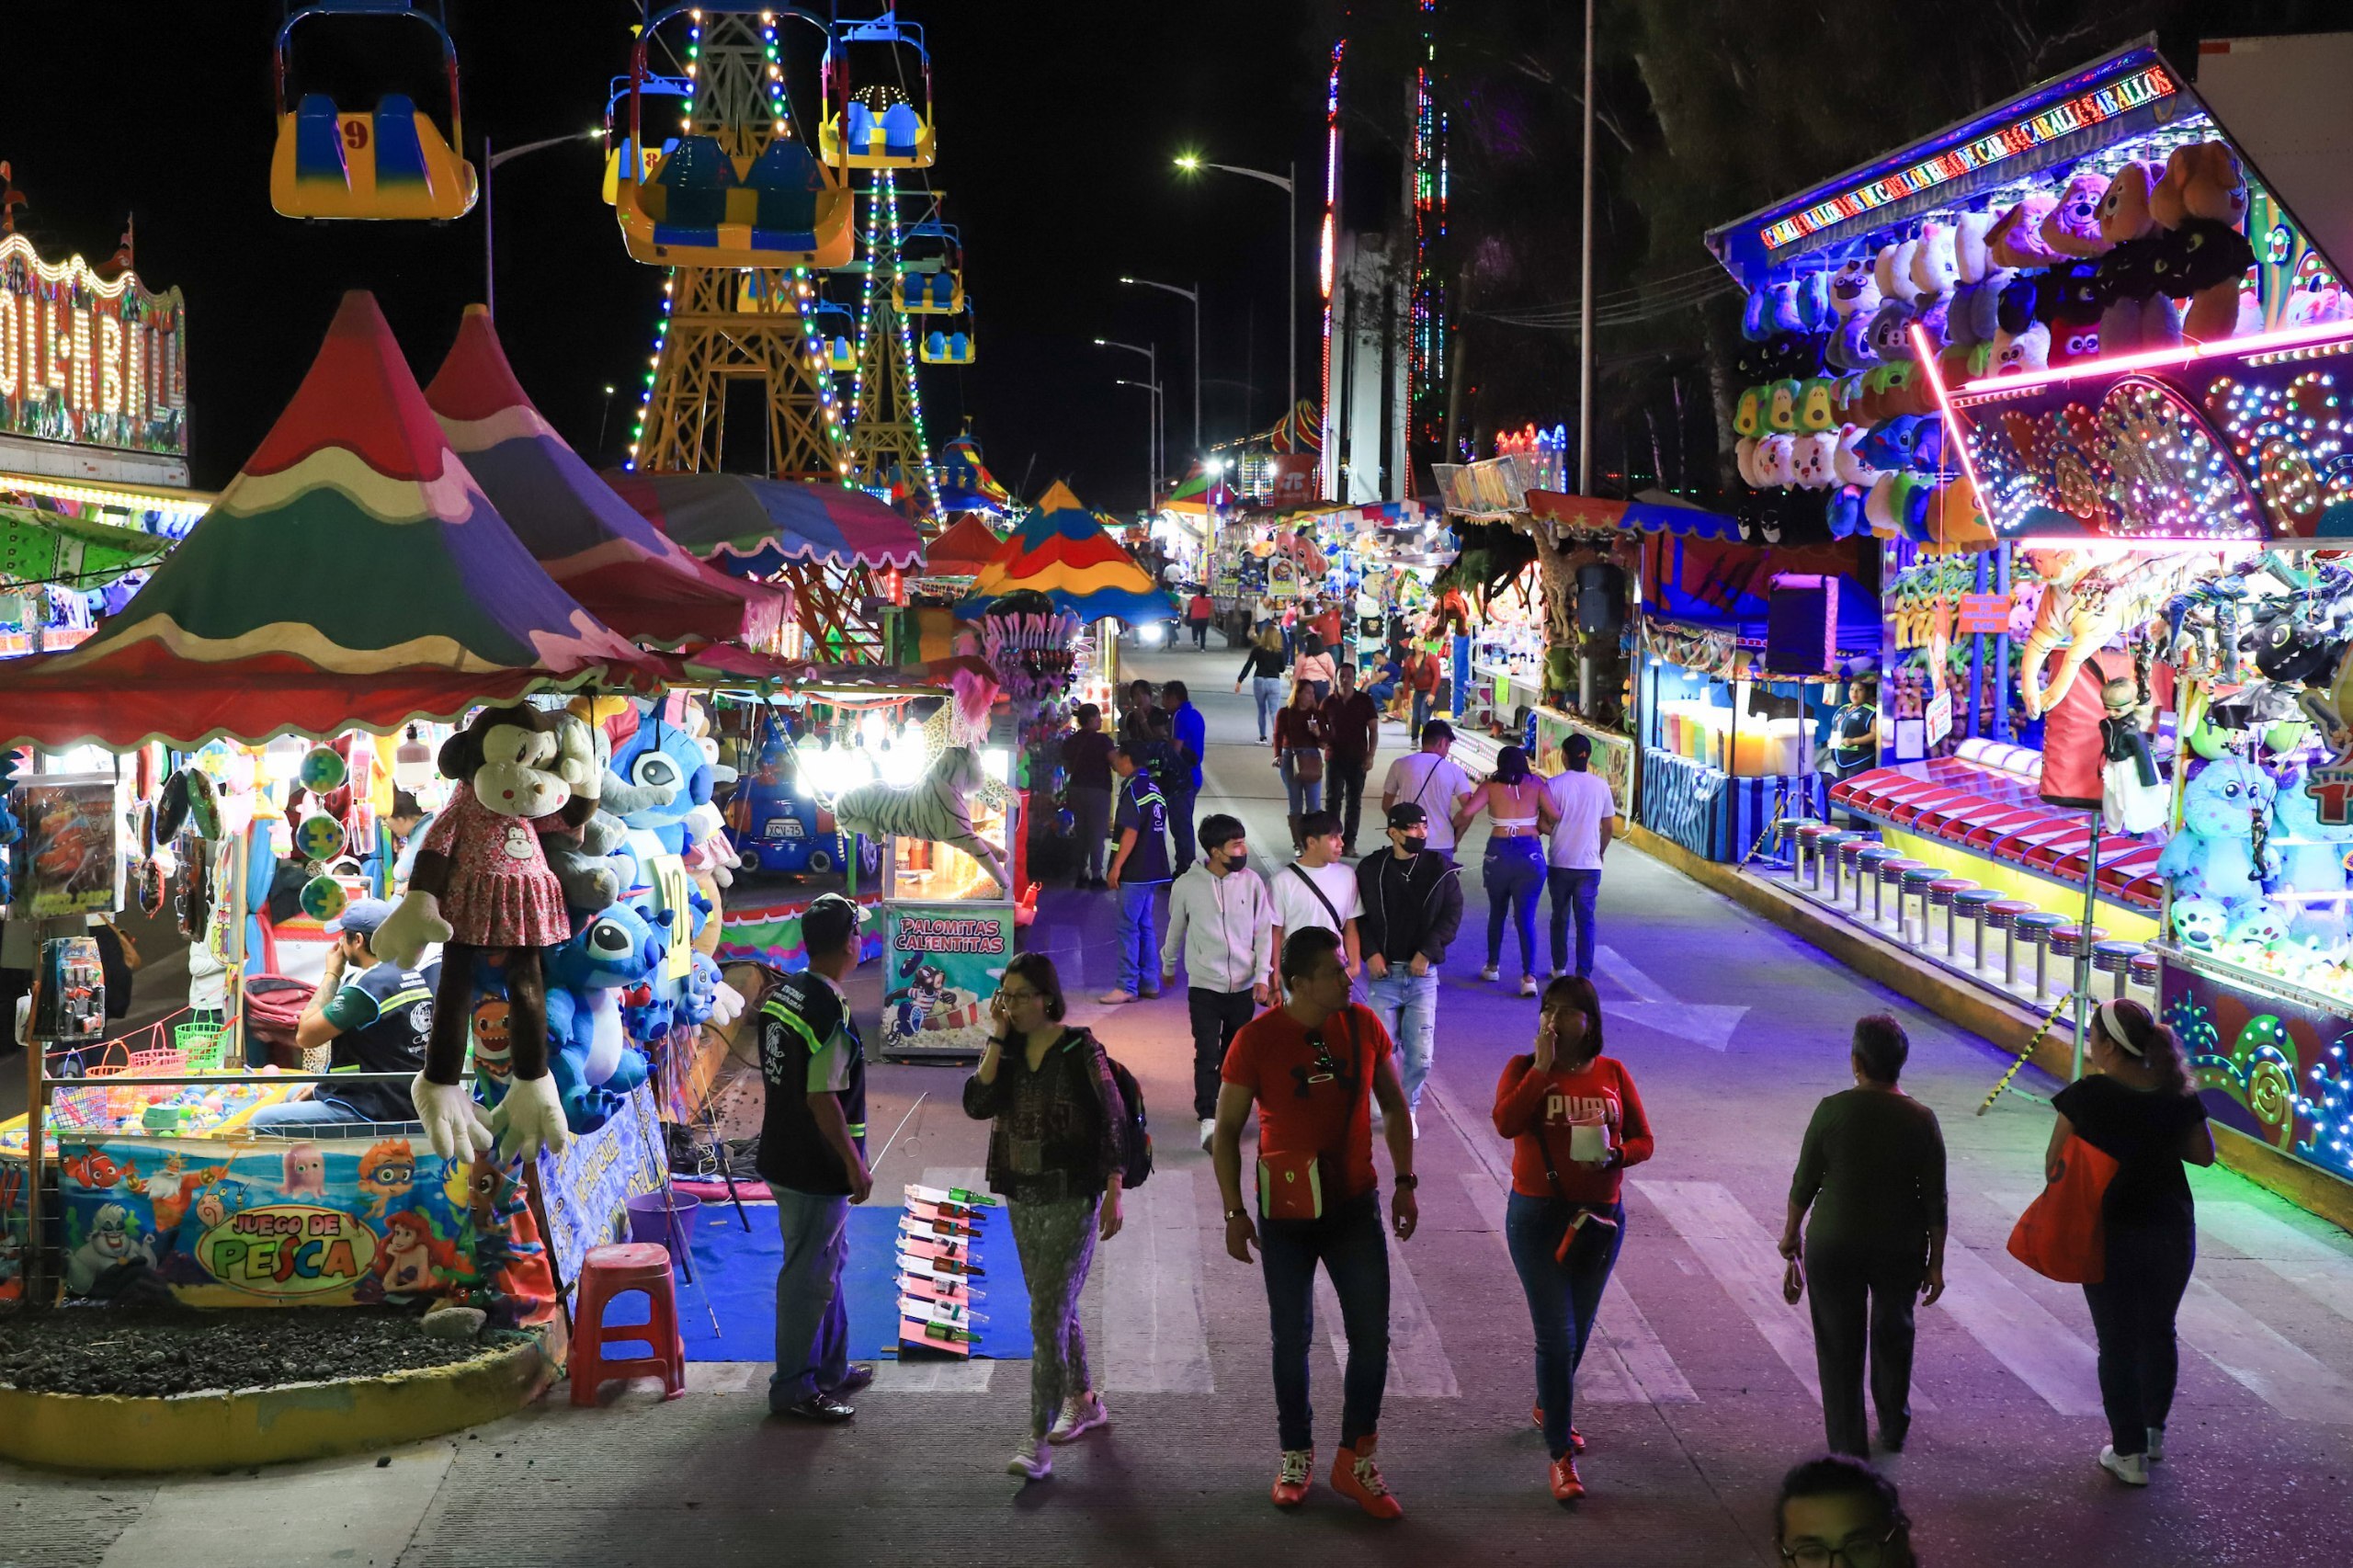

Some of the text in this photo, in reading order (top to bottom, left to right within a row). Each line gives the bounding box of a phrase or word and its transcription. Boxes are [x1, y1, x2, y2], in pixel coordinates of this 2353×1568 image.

[344, 120, 369, 150] 9
[645, 152, 659, 169] 8
[768, 825, 801, 836] XCV-75
[900, 917, 999, 937] PALOMITAS
[894, 935, 1005, 954] CALIENTITAS
[232, 1213, 341, 1237] JUEGO DE
[212, 1235, 358, 1283] PESCA
